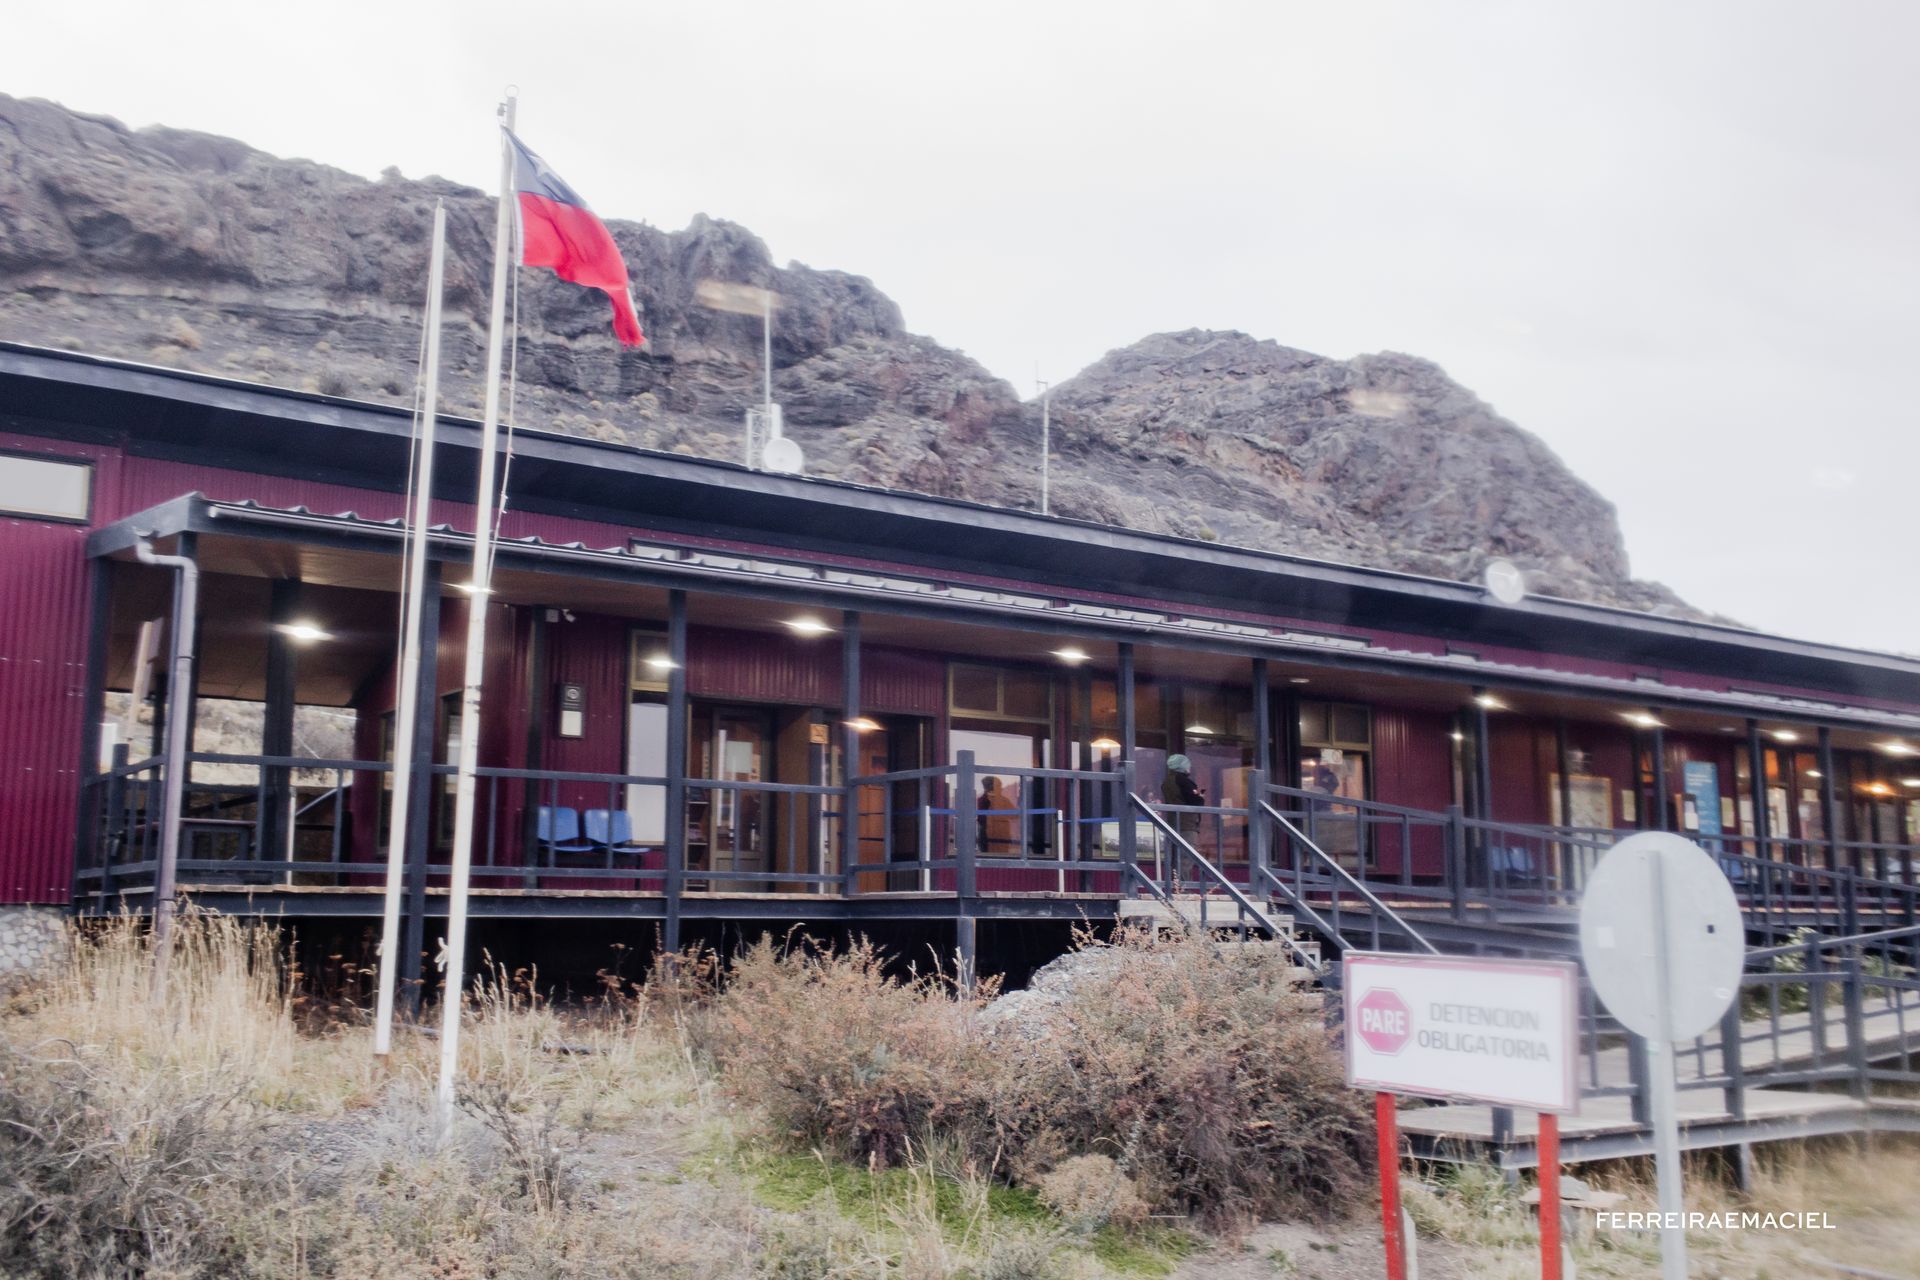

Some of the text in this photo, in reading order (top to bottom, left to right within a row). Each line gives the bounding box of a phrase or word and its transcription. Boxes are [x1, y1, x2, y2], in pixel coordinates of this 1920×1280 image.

[1361, 1007, 1406, 1036] PARE
[1429, 1002, 1540, 1031] DETENCION
[1417, 1029, 1551, 1062] OBLIGATORIA
